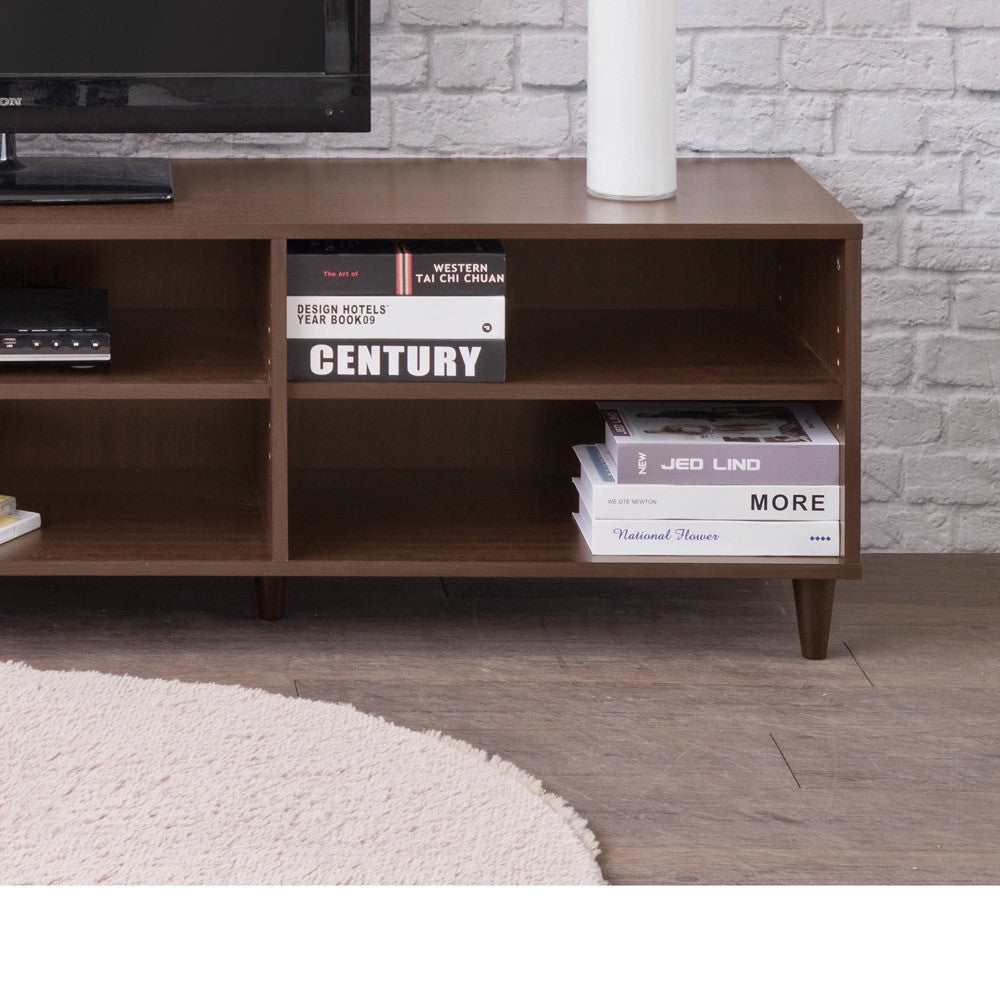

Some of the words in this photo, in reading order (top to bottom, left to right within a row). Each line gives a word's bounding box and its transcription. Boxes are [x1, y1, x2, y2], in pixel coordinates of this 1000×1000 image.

[323, 270, 337, 278] The
[338, 270, 350, 278] Art
[350, 270, 359, 278] of
[433, 263, 488, 273] WESTERN
[415, 273, 435, 283] TAI
[439, 273, 460, 283] CHI
[464, 273, 505, 283] CHUAN
[297, 304, 338, 315] DESIGN
[297, 315, 326, 325] YEAR
[309, 343, 482, 377] CENTURY
[637, 452, 647, 475] NEW
[661, 458, 704, 471] JED
[713, 458, 761, 471] LIND
[750, 493, 826, 512] MORE
[612, 528, 671, 541] National
[674, 528, 720, 541] Flower
